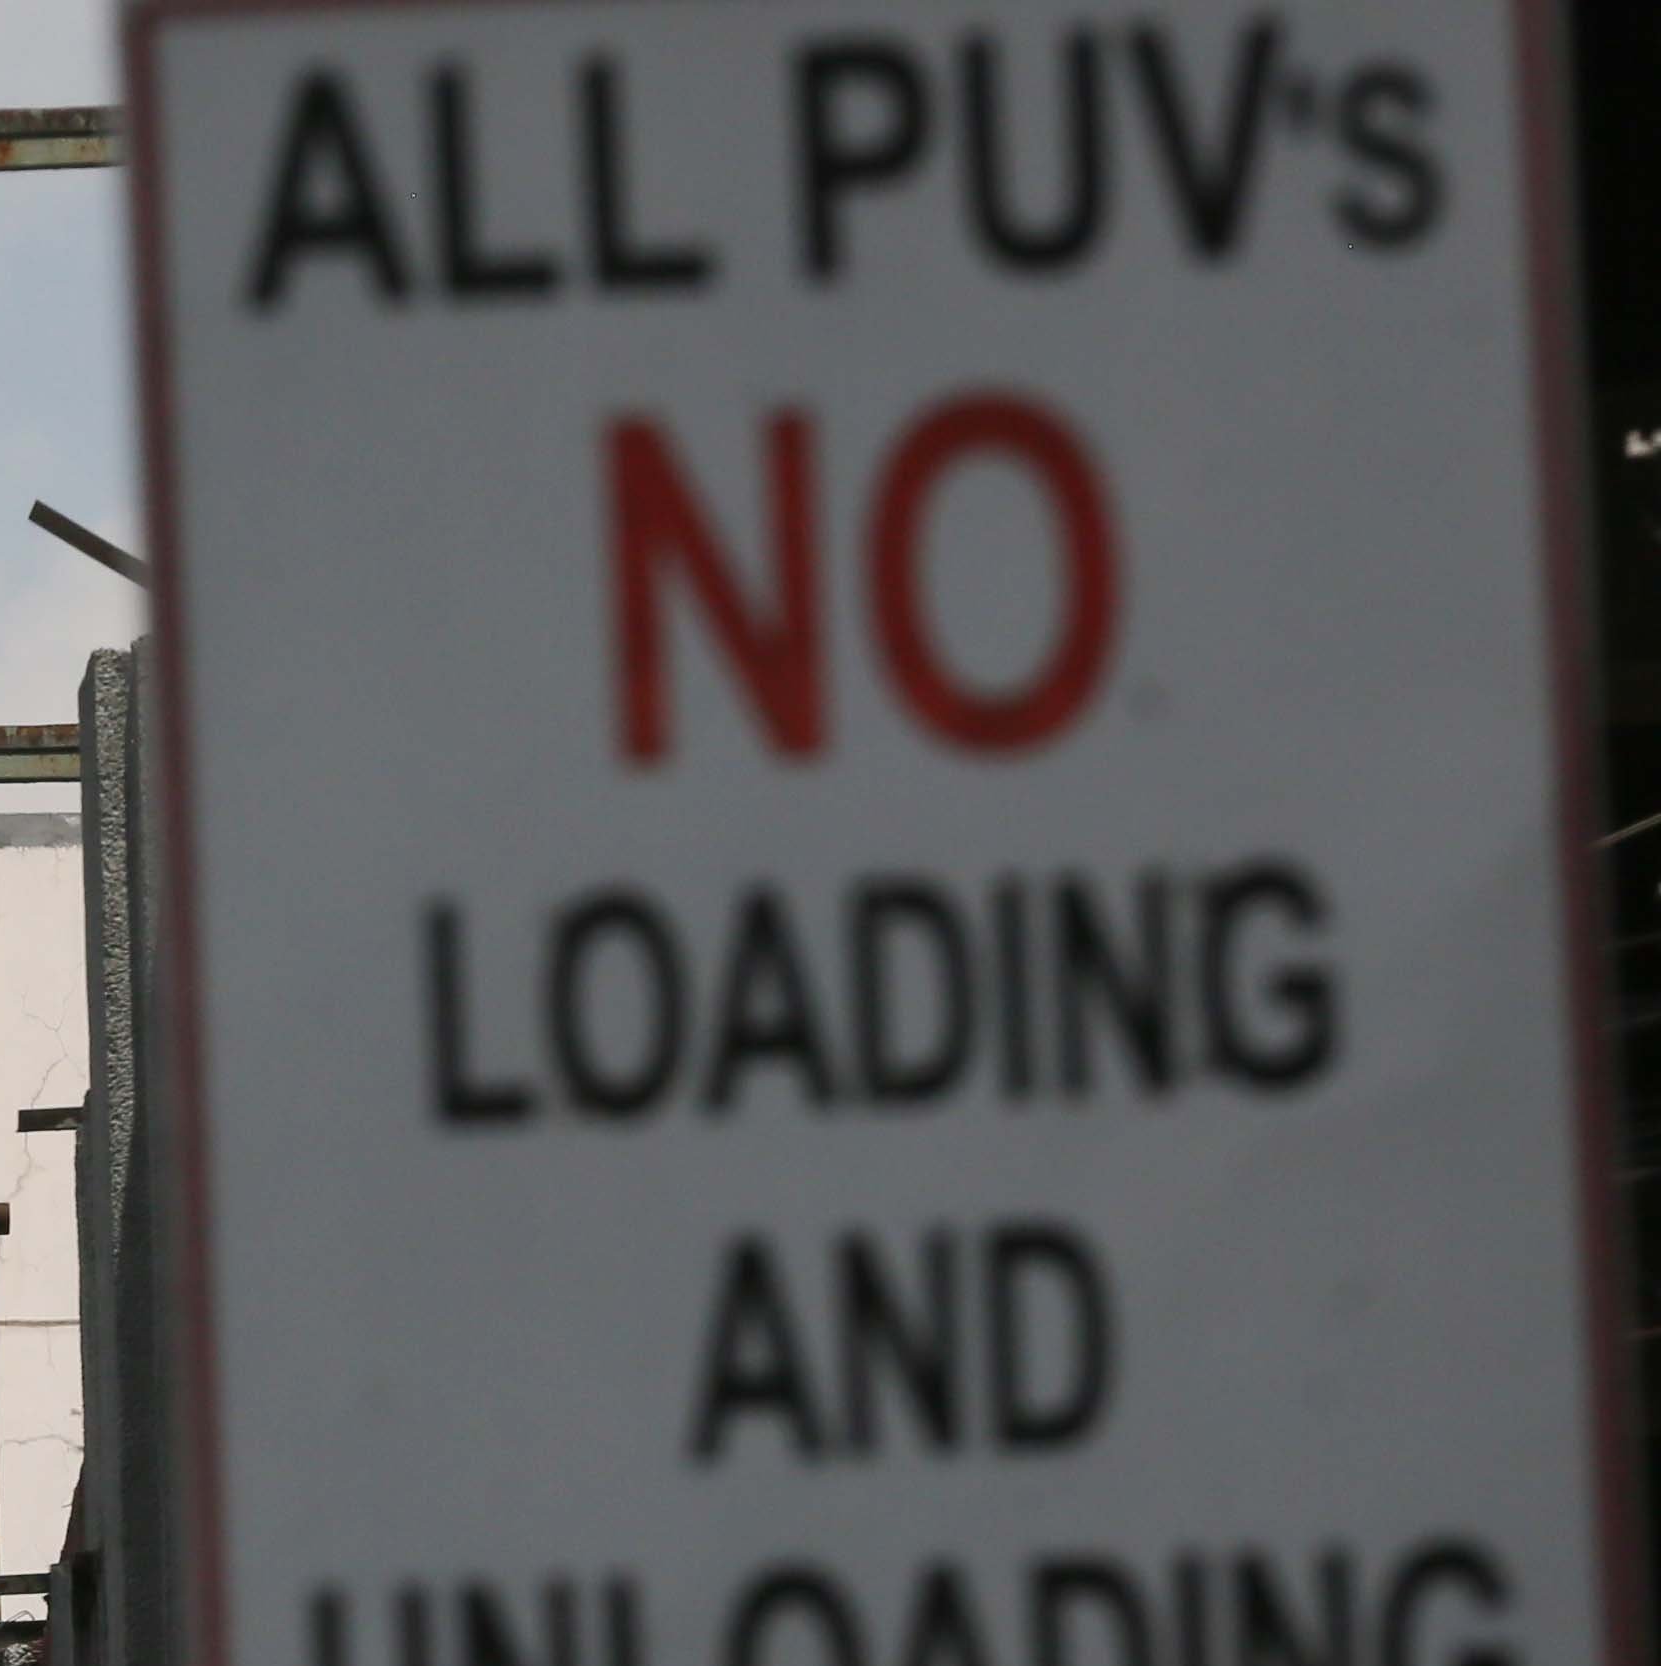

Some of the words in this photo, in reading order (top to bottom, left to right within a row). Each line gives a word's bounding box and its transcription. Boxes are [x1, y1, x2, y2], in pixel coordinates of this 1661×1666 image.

[248, 57, 716, 311] ALL
[605, 390, 1124, 765] NO
[424, 857, 1342, 1132] LOADING
[689, 1218, 1116, 1464] AND
